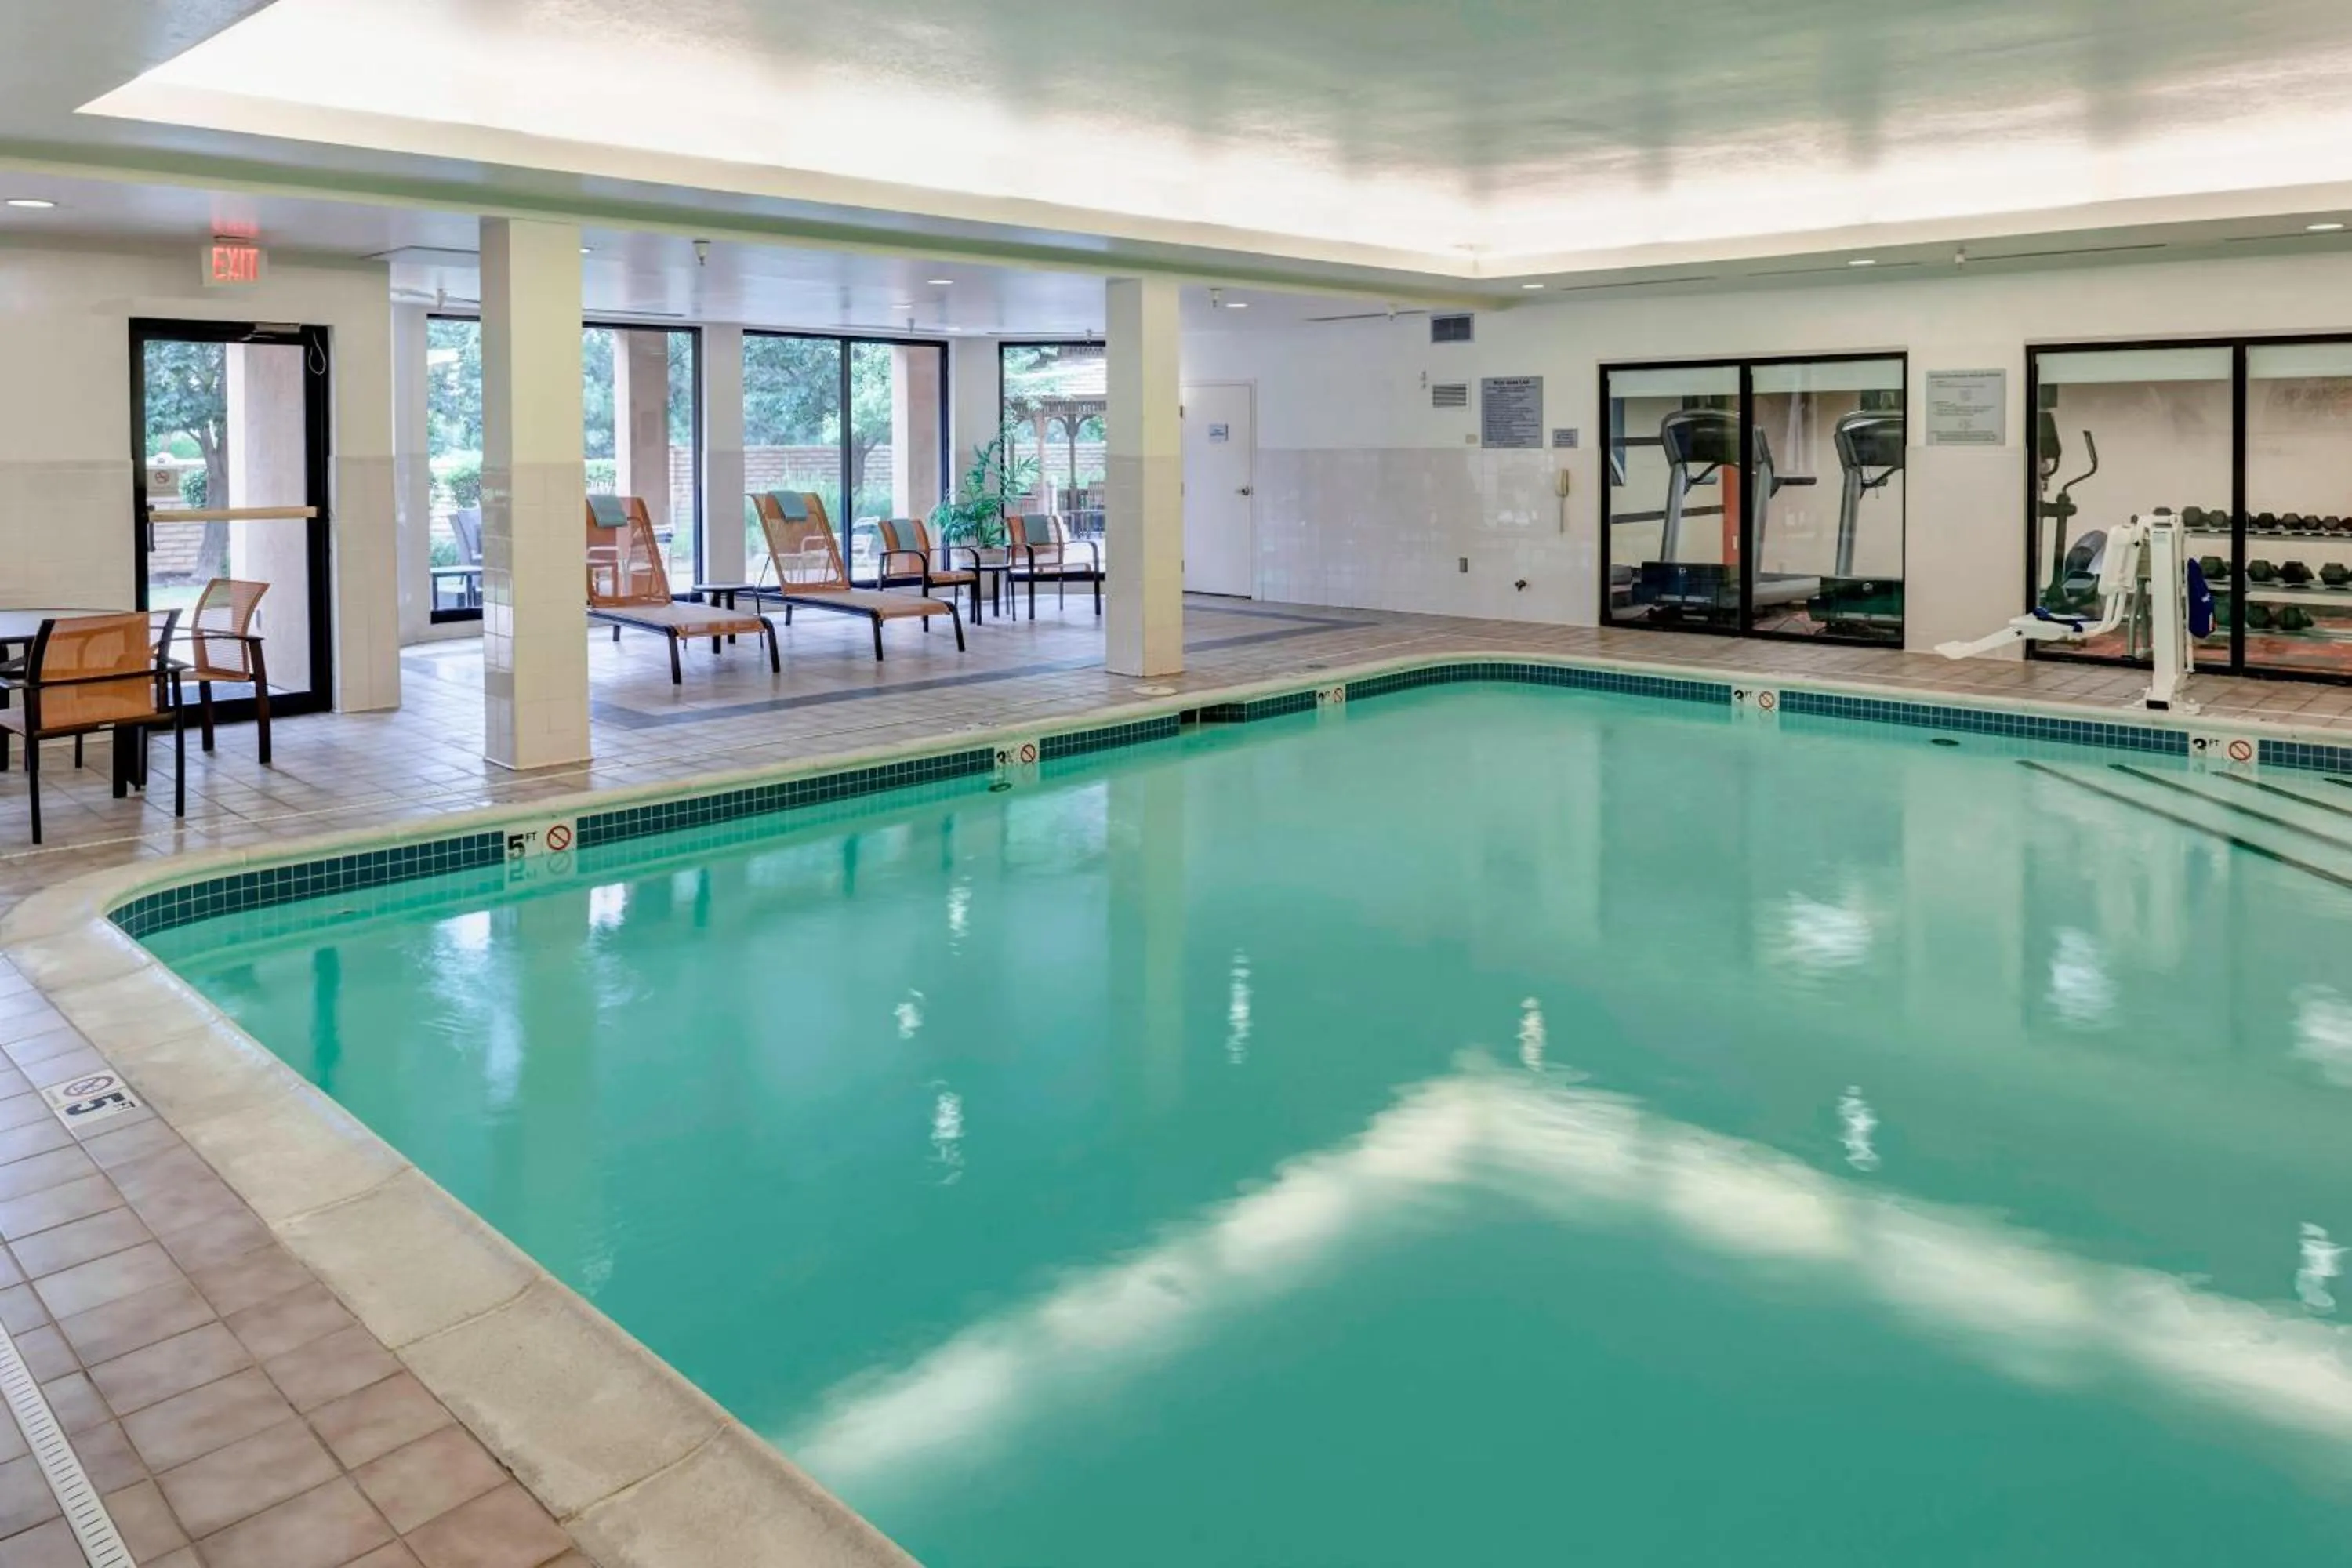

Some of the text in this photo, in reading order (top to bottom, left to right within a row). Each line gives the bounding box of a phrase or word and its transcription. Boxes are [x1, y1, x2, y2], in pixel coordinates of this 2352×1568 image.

[212, 247, 259, 281] EXIT
[508, 831, 538, 860] 5 FT
[66, 1092, 125, 1115] 5
